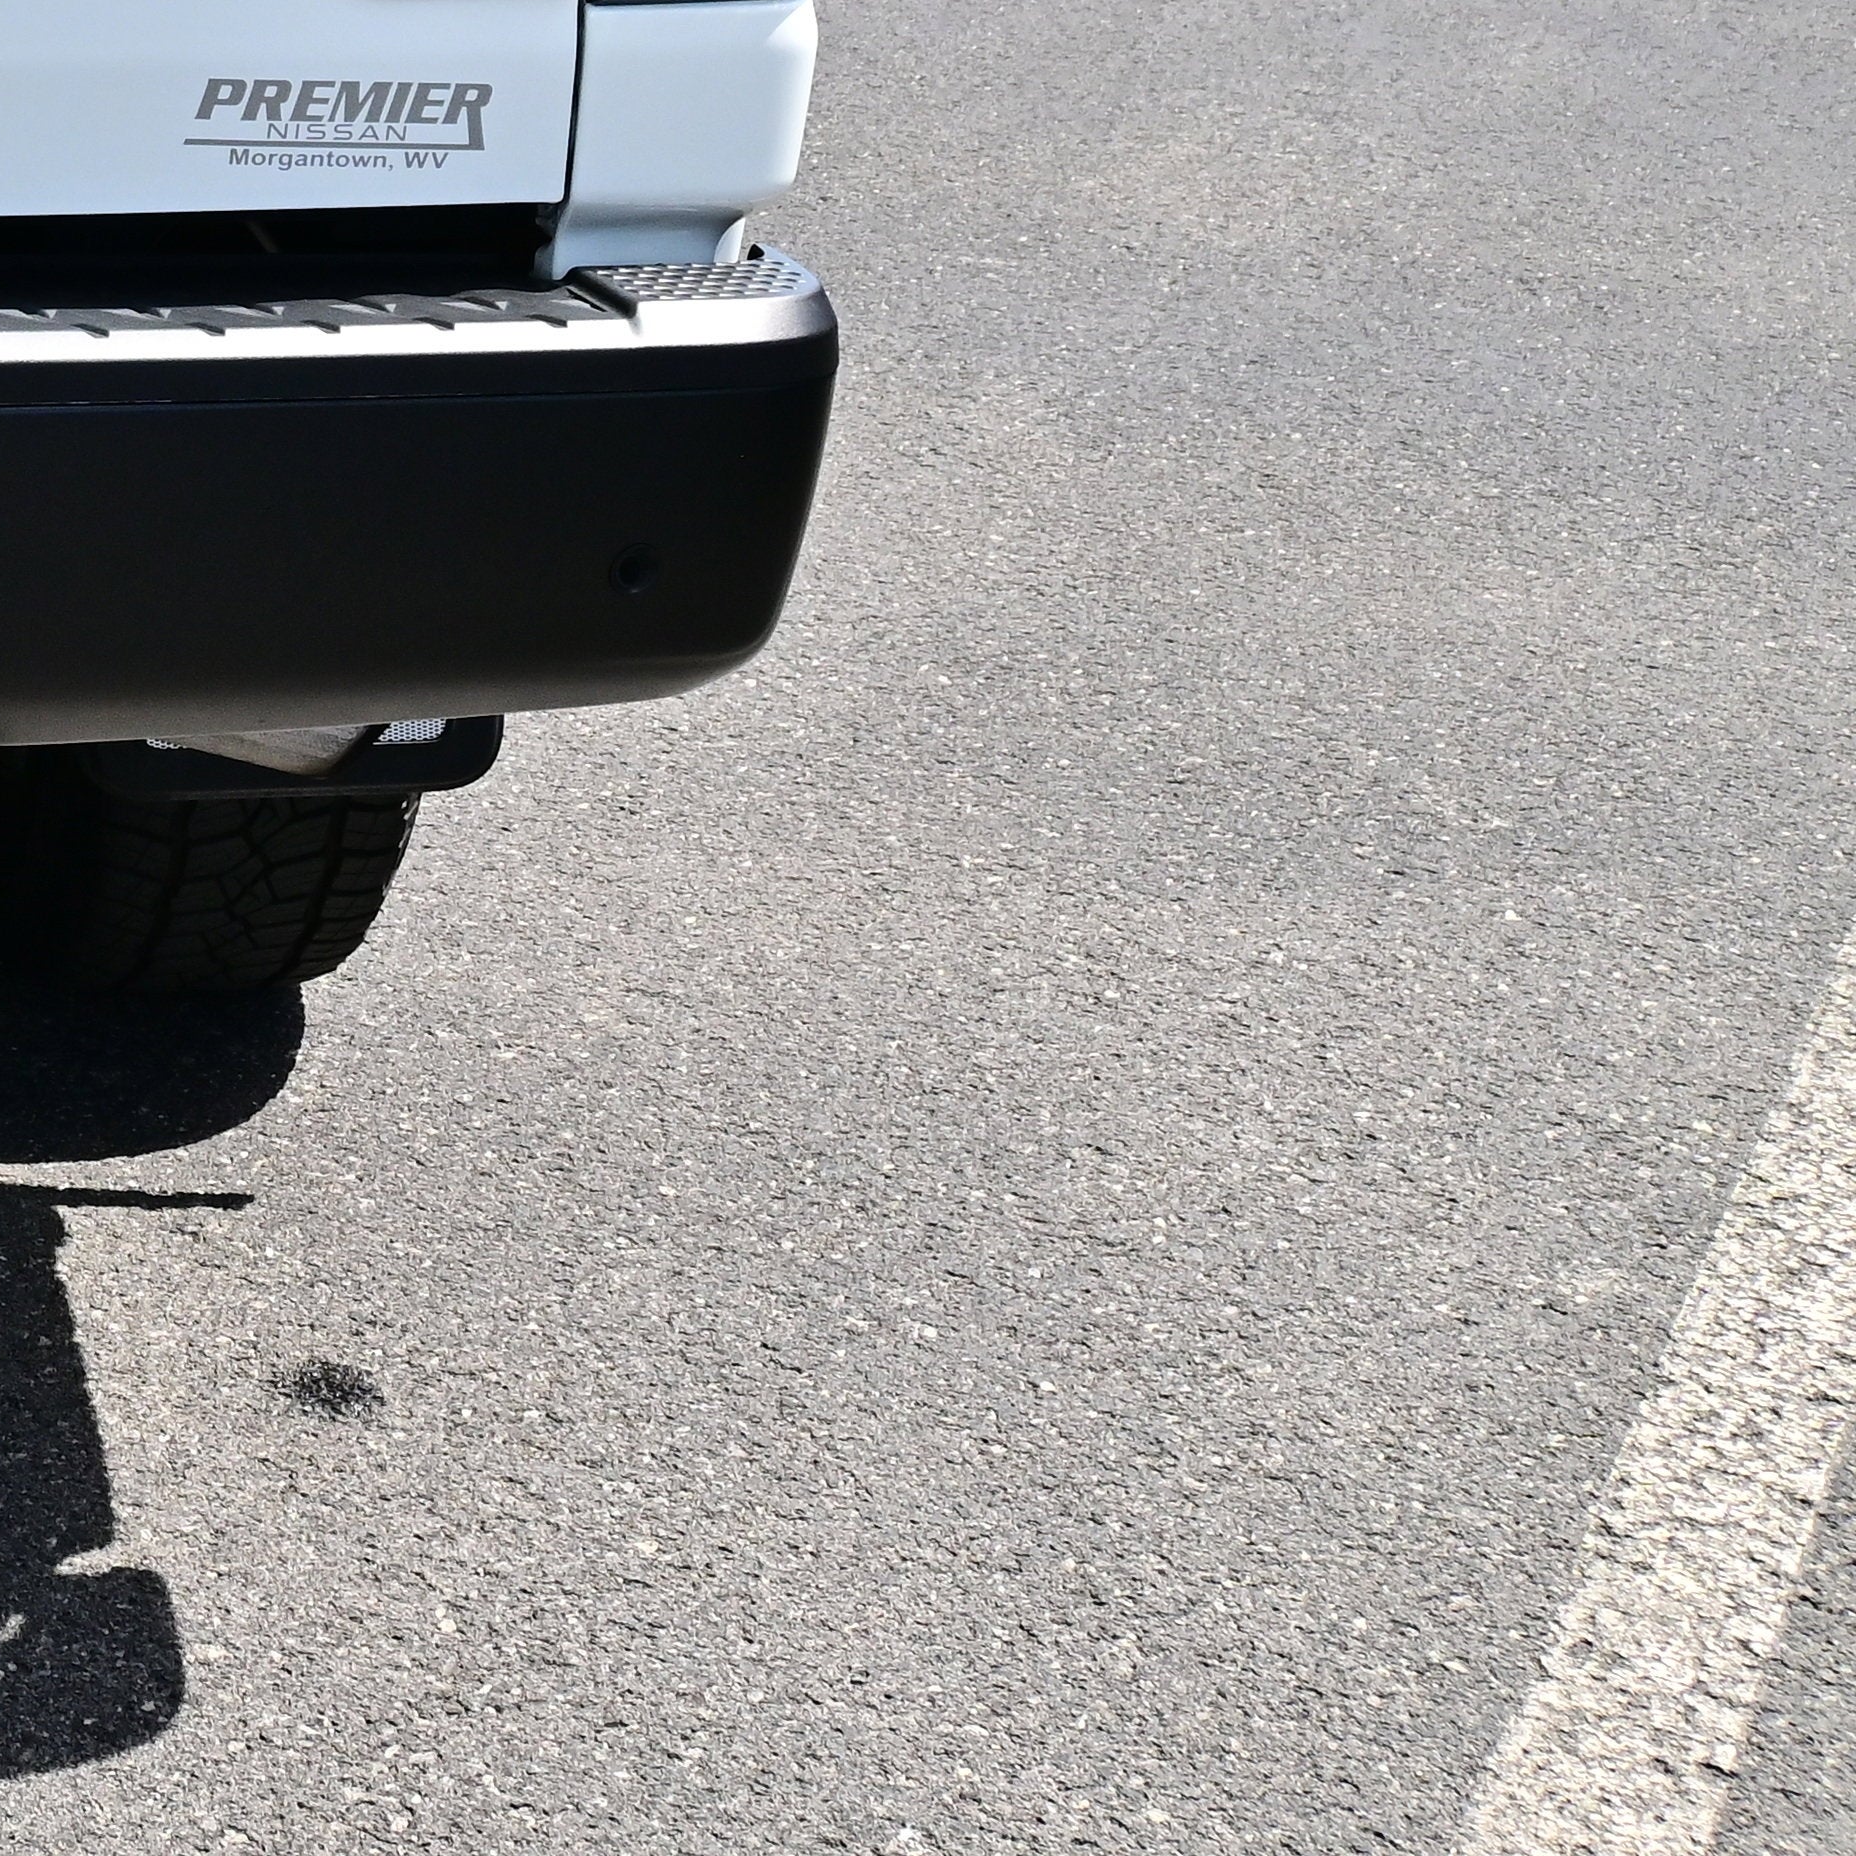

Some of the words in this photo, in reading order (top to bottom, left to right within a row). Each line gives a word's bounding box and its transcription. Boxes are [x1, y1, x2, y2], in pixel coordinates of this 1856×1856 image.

[194, 77, 493, 144] PREMIER
[266, 122, 408, 142] NISSAN
[228, 148, 394, 171] Morgantown,
[403, 151, 450, 169] WV
